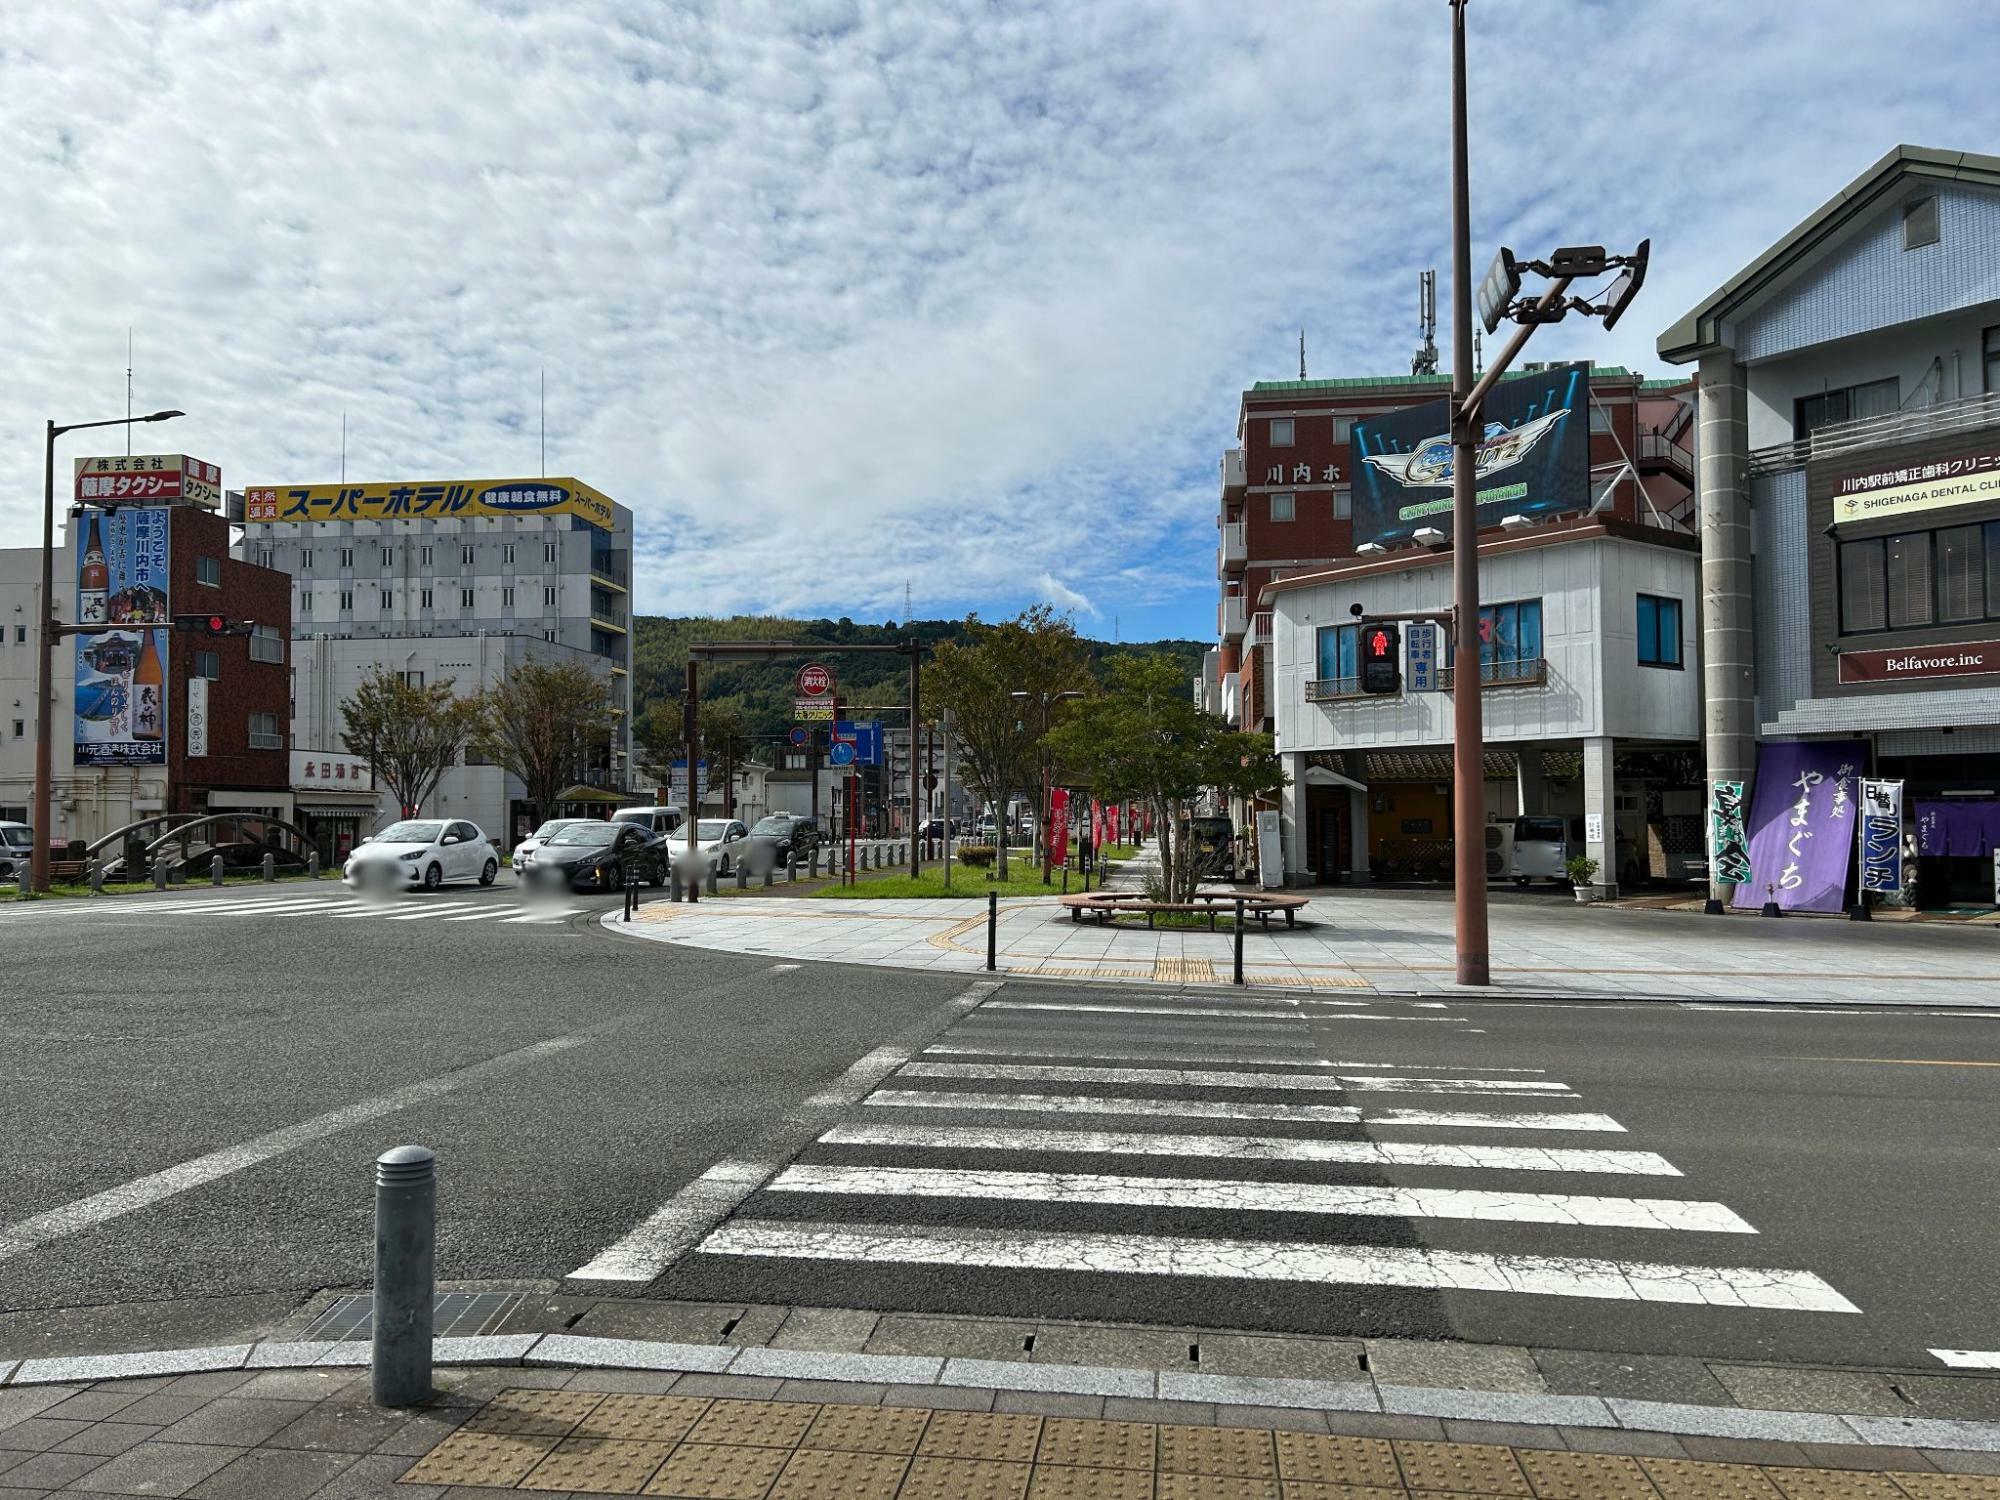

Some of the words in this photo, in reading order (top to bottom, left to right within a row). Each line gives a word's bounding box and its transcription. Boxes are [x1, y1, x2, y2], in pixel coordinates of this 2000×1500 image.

[97, 457, 164, 471] 株式会社
[188, 458, 218, 482] 薩摩
[81, 476, 180, 498] 薩摩タクシー
[185, 479, 221, 501] タクシー
[250, 489, 277, 504] 天然
[484, 489, 562, 504] 健康朝食無料
[1863, 491, 1928, 510] SHIGENAGA
[1931, 484, 1977, 499] DENTAL
[250, 505, 277, 519] 温泉
[282, 485, 475, 518] スーパーホテル
[574, 490, 612, 520] スーパーホテル
[135, 510, 151, 593] 薩摩川内市へ
[1410, 629, 1420, 659] 自転車
[1421, 629, 1432, 659] 歩行者
[1415, 661, 1428, 688] 専用
[1886, 653, 1983, 672] Belfavore.inc
[1780, 769, 1823, 889] やまぐち
[1865, 817, 1900, 888] ランチ
